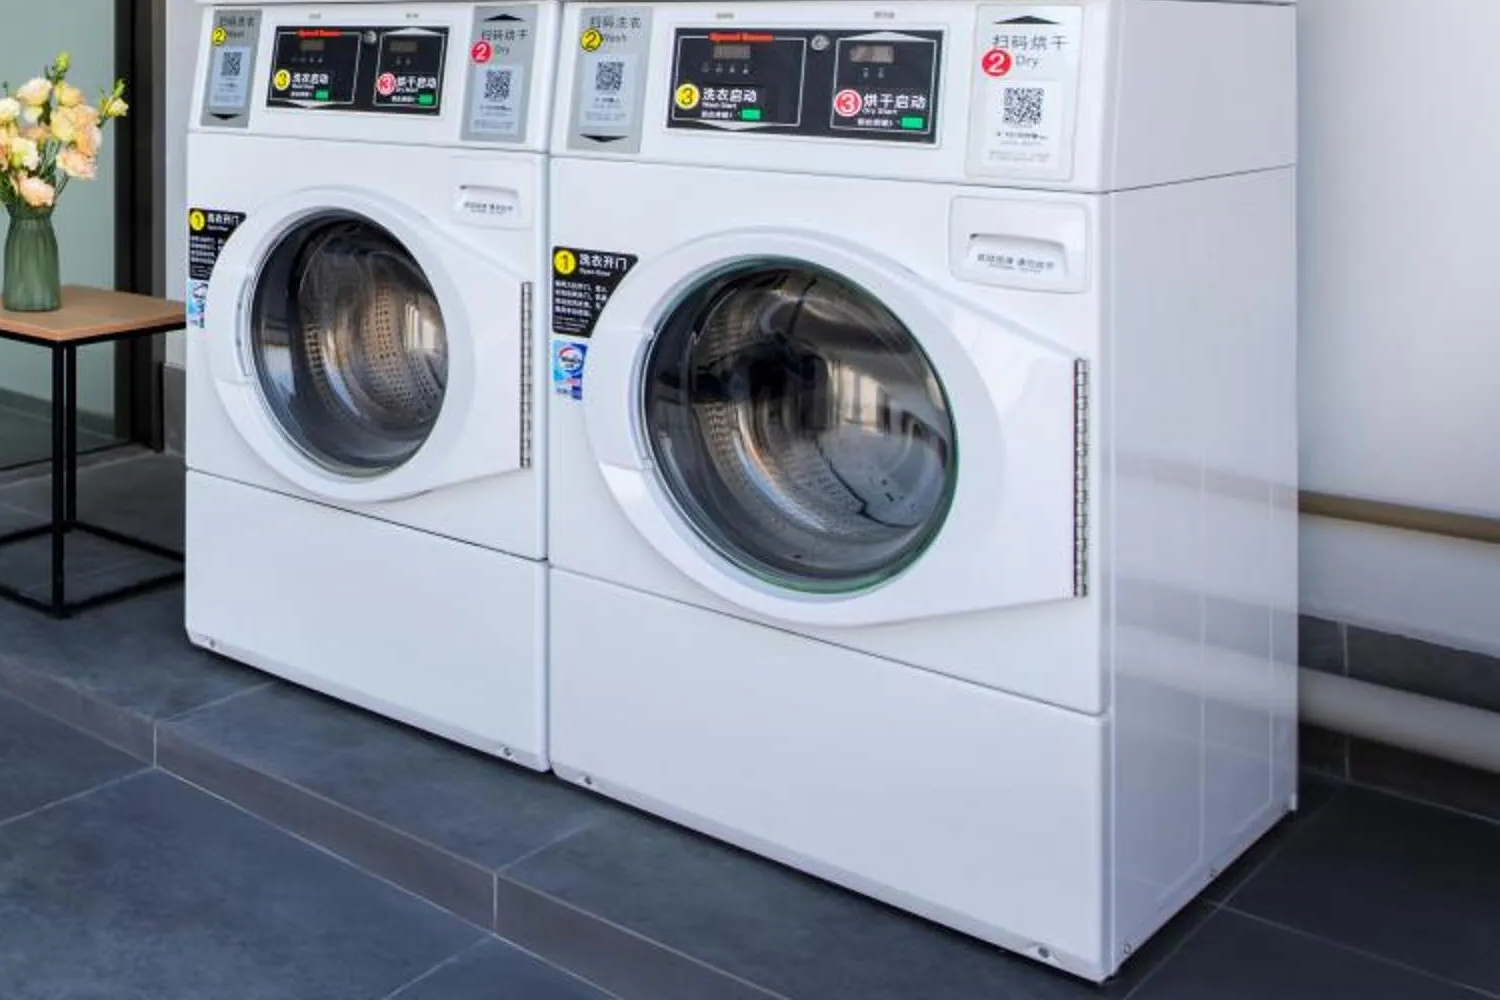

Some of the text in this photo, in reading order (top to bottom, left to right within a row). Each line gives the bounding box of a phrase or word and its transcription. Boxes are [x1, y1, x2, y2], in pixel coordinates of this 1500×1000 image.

[992, 34, 1070, 51] 扫码烘干
[1016, 55, 1041, 70] Dry
[863, 93, 927, 110] 烘干启动
